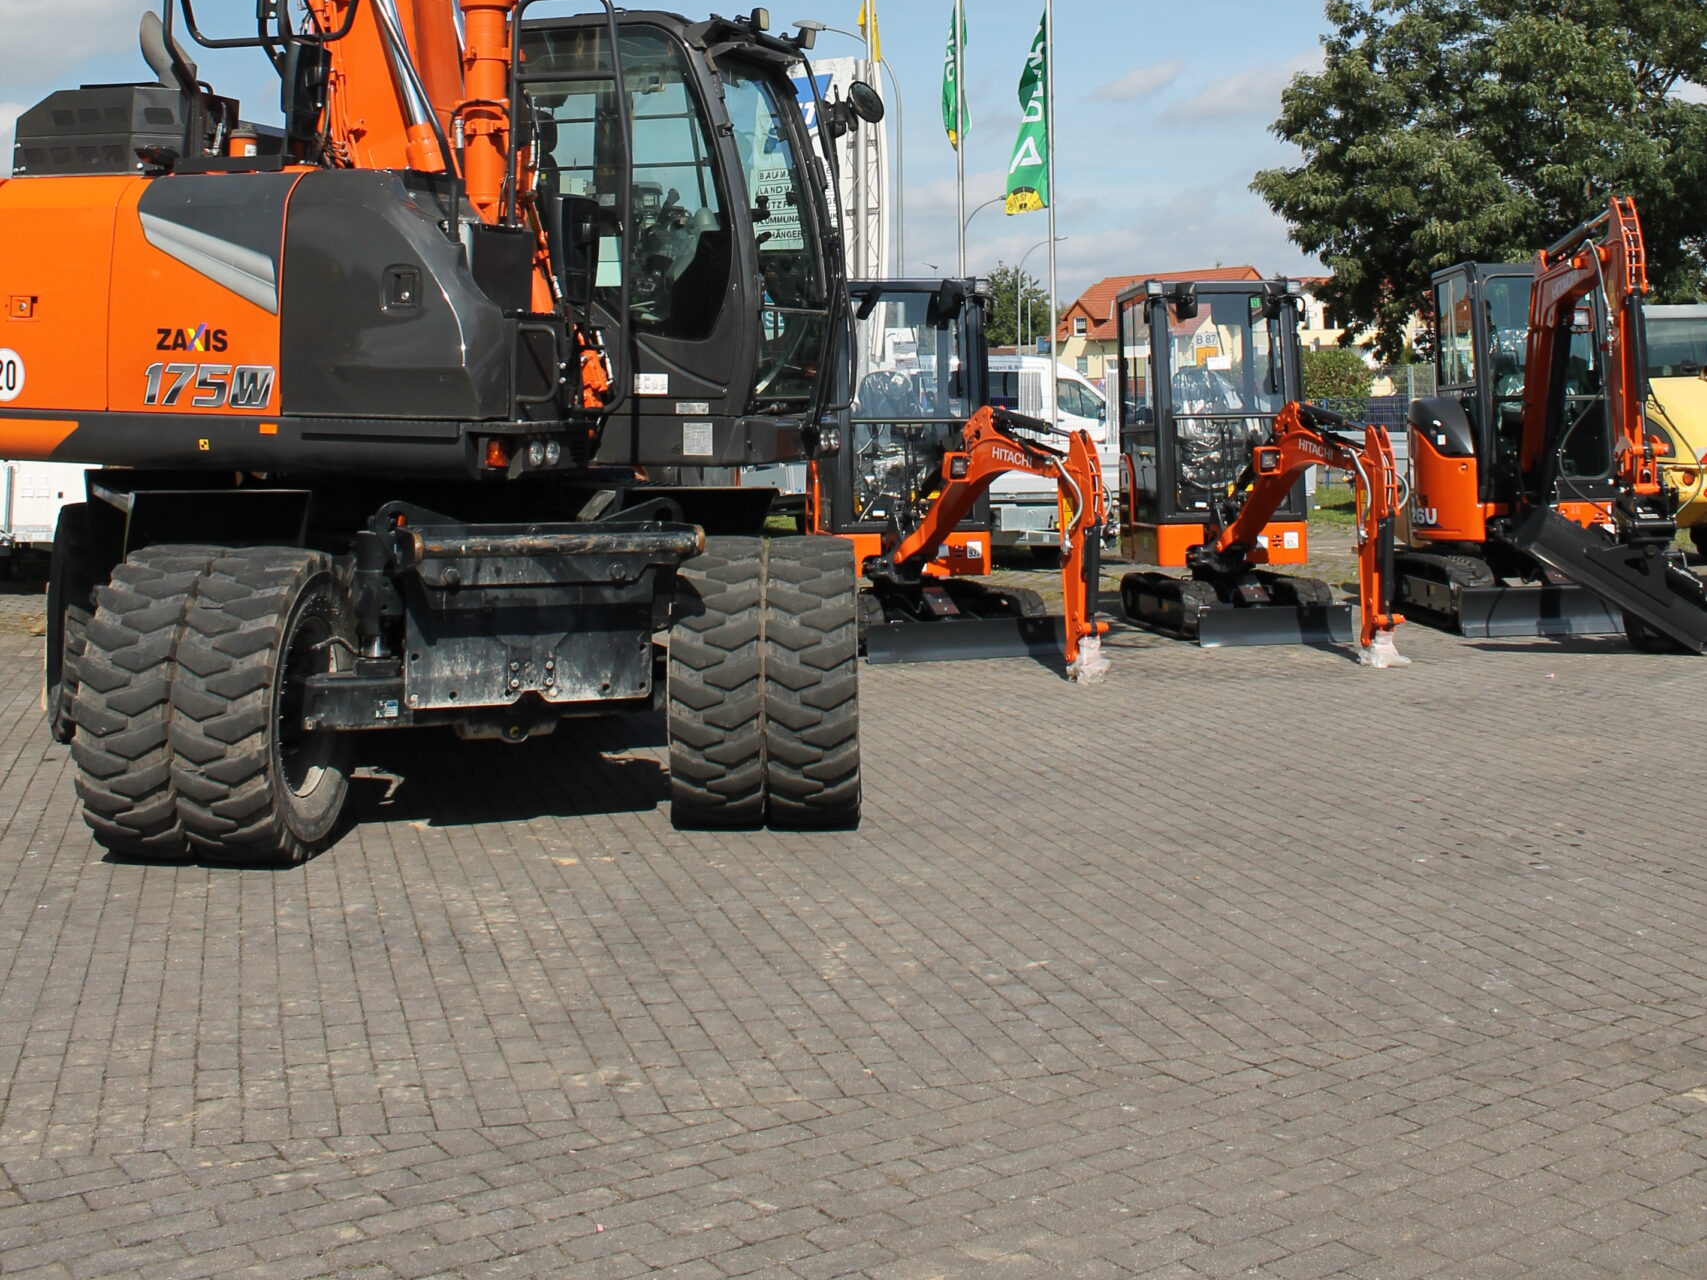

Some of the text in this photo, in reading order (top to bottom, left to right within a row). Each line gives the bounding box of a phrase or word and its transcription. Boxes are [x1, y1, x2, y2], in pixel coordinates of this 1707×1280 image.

[156, 321, 228, 352] ZAXIS
[1196, 333, 1217, 345] B 87
[144, 362, 276, 410] 175W
[991, 446, 1032, 469] HITACHI
[1298, 438, 1333, 461] HITACHI
